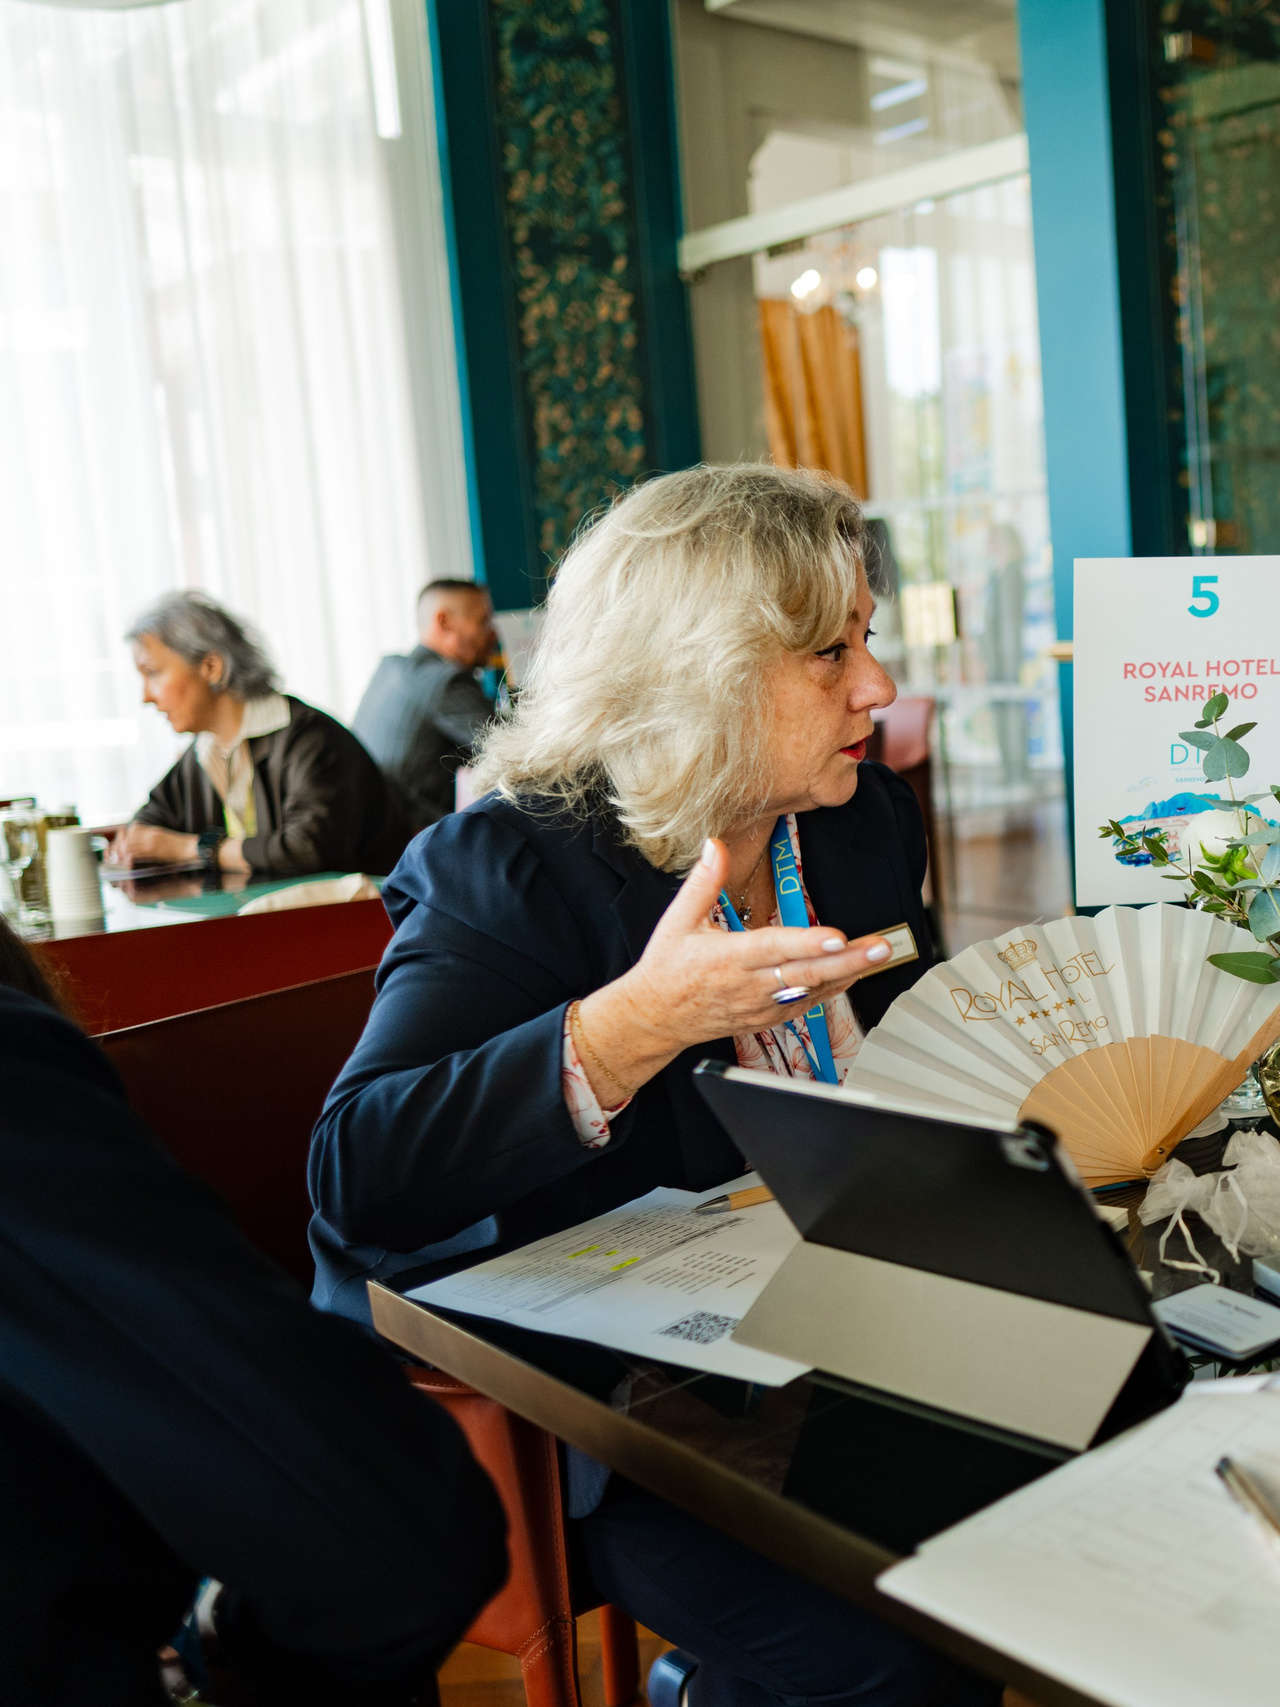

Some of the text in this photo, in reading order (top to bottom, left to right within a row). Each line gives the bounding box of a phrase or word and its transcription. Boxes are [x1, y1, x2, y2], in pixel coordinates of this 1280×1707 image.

[1187, 575, 1220, 618] 5
[1123, 659, 1280, 679] ROYAL HOTEL
[774, 839, 800, 894] DTM
[950, 950, 1116, 1023] ROYAL HOTEL
